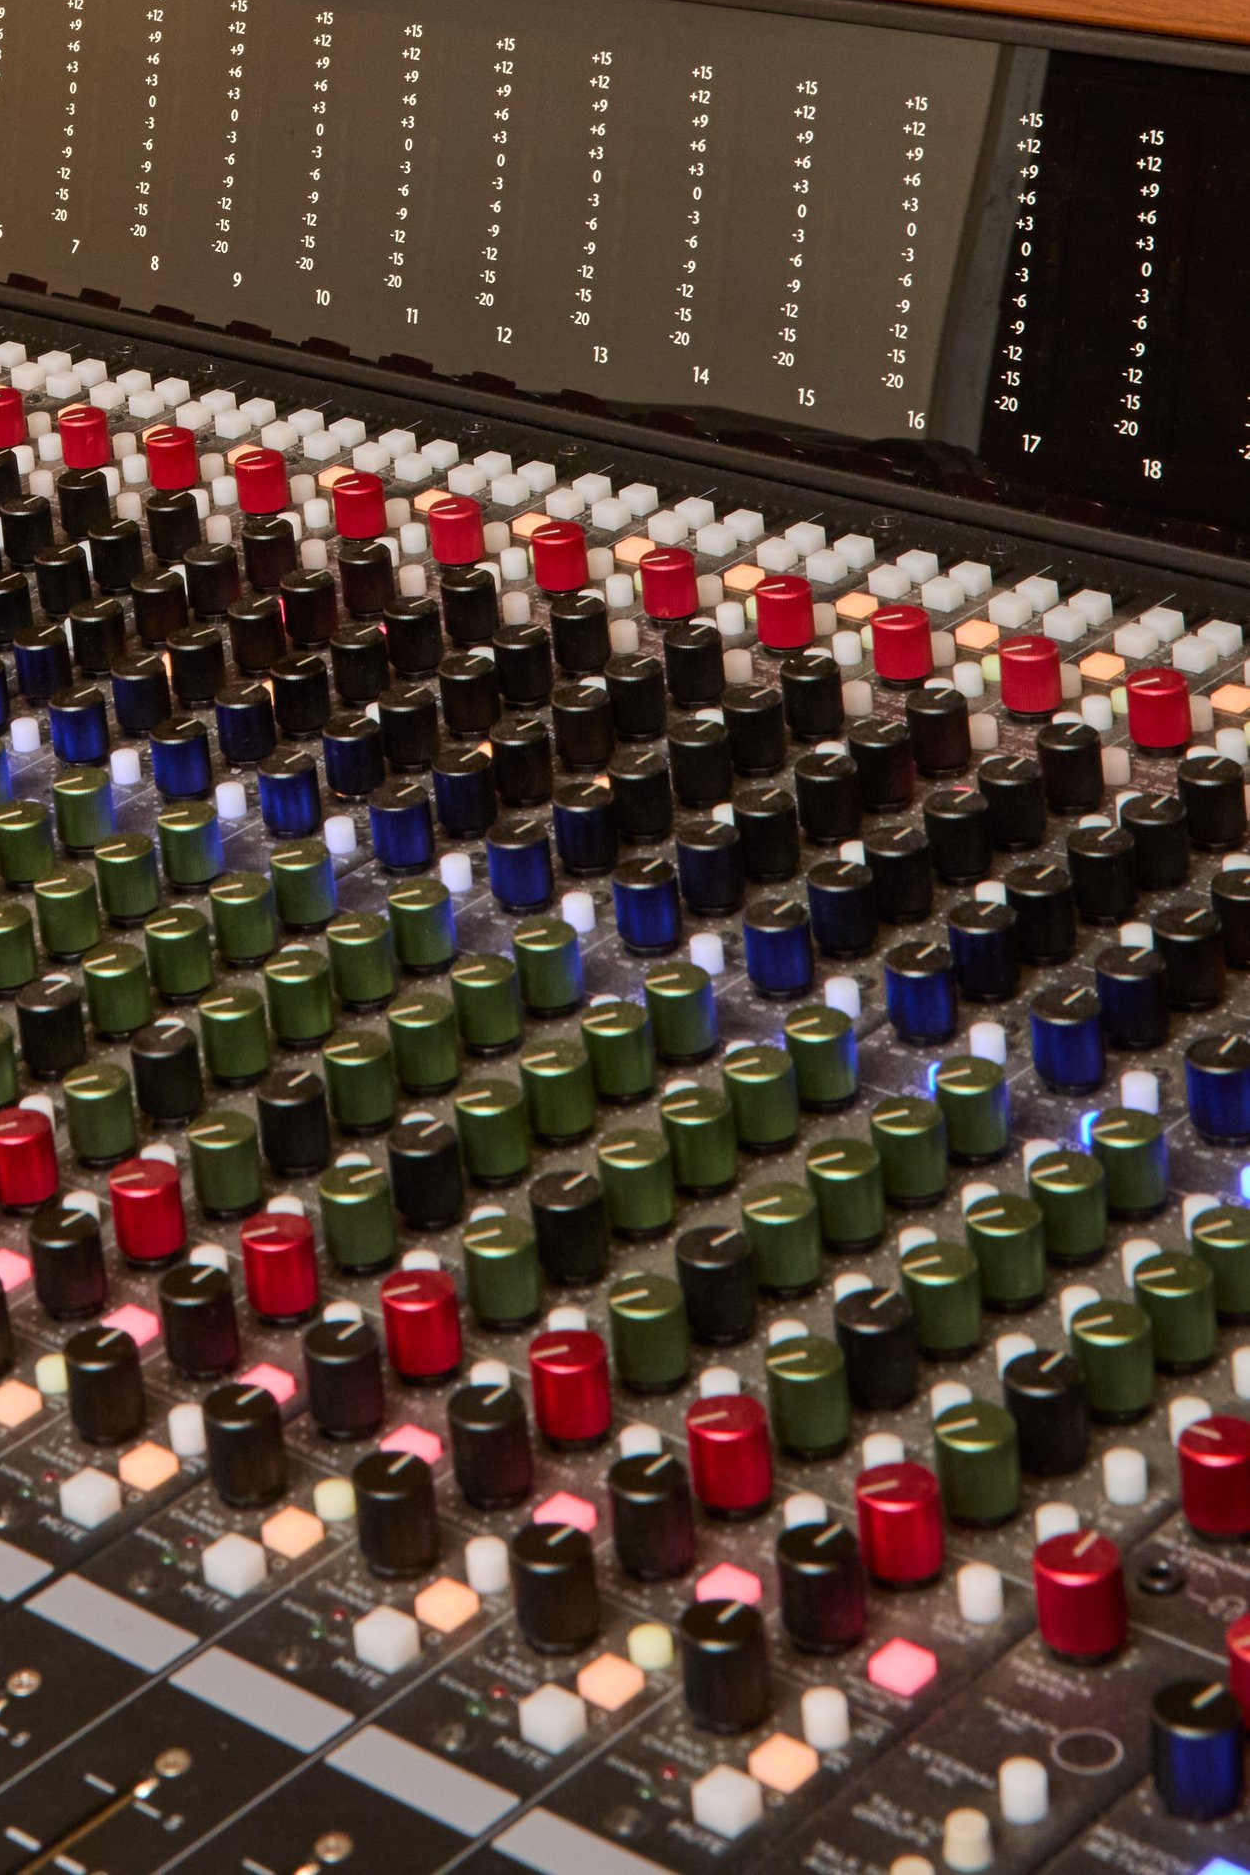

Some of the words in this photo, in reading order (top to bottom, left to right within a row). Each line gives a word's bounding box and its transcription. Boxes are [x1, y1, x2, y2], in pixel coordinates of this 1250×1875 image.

[145, 8, 164, 23] +12
[148, 30, 163, 44] +9
[146, 52, 160, 65] +6
[591, 50, 613, 66] +15
[144, 73, 159, 87] +3
[589, 74, 611, 90] +12
[148, 94, 157, 108] 0
[591, 98, 609, 113] +9
[144, 116, 155, 130] -3
[589, 122, 606, 137] +6
[142, 138, 154, 151] -6
[1138, 129, 1165, 146] +15
[588, 145, 604, 160] +3
[140, 160, 152, 173] -9
[1136, 155, 1163, 173] +12
[592, 169, 602, 184] 0
[135, 181, 151, 195] -12
[1139, 182, 1160, 198] +9
[587, 193, 600, 207] -3
[133, 202, 149, 217] -15
[1136, 209, 1157, 225] +6
[129, 223, 147, 238] -20
[584, 217, 598, 231] -6
[71, 238, 81, 254] 7
[582, 241, 596, 256] -9
[1135, 235, 1155, 252] +3
[150, 255, 160, 271] 8
[1140, 261, 1153, 278] 0
[232, 271, 243, 288] 9
[576, 264, 594, 280] -12
[315, 288, 331, 307] 10
[574, 287, 592, 303] -15
[1134, 288, 1150, 304] -3
[406, 307, 419, 325] 11
[569, 310, 591, 326] -20
[1131, 314, 1148, 331] -6
[496, 325, 513, 345] 12
[592, 345, 609, 364] 13
[1129, 342, 1146, 358] -9
[692, 365, 710, 385] 14
[1121, 367, 1144, 385] -12
[797, 387, 816, 407] 15
[1119, 393, 1141, 411] -15
[907, 410, 926, 430] 16
[1113, 419, 1139, 437] -20
[1021, 433, 1042, 454] 17
[1142, 458, 1163, 480] 18
[37, 1515, 86, 1543] MUTE
[180, 1581, 232, 1613] MUTE
